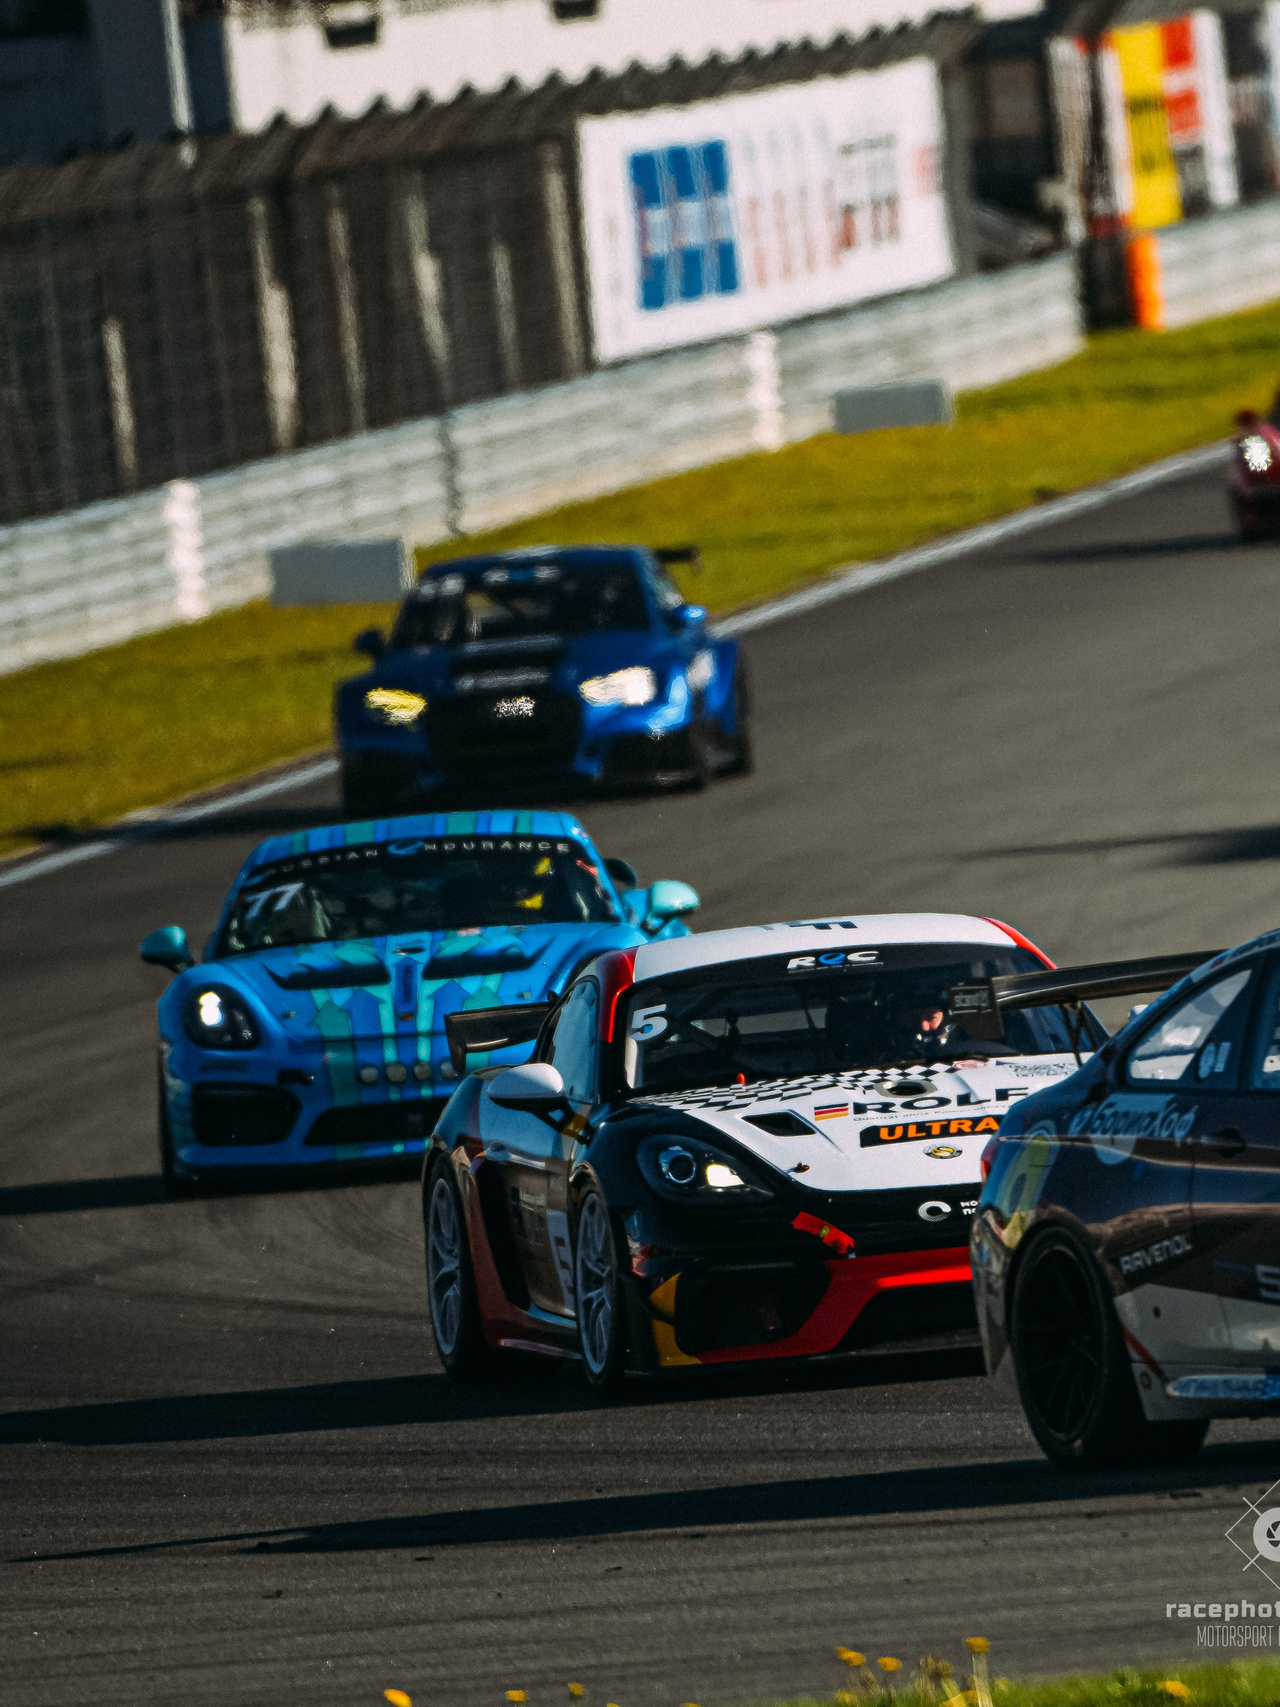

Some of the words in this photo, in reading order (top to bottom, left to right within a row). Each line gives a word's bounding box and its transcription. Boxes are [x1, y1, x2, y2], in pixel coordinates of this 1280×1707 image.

[630, 1003, 669, 1042] 5
[853, 1087, 1029, 1114] ROLF
[879, 1115, 999, 1140] ULTRA
[1119, 1234, 1195, 1275] RAVENOL
